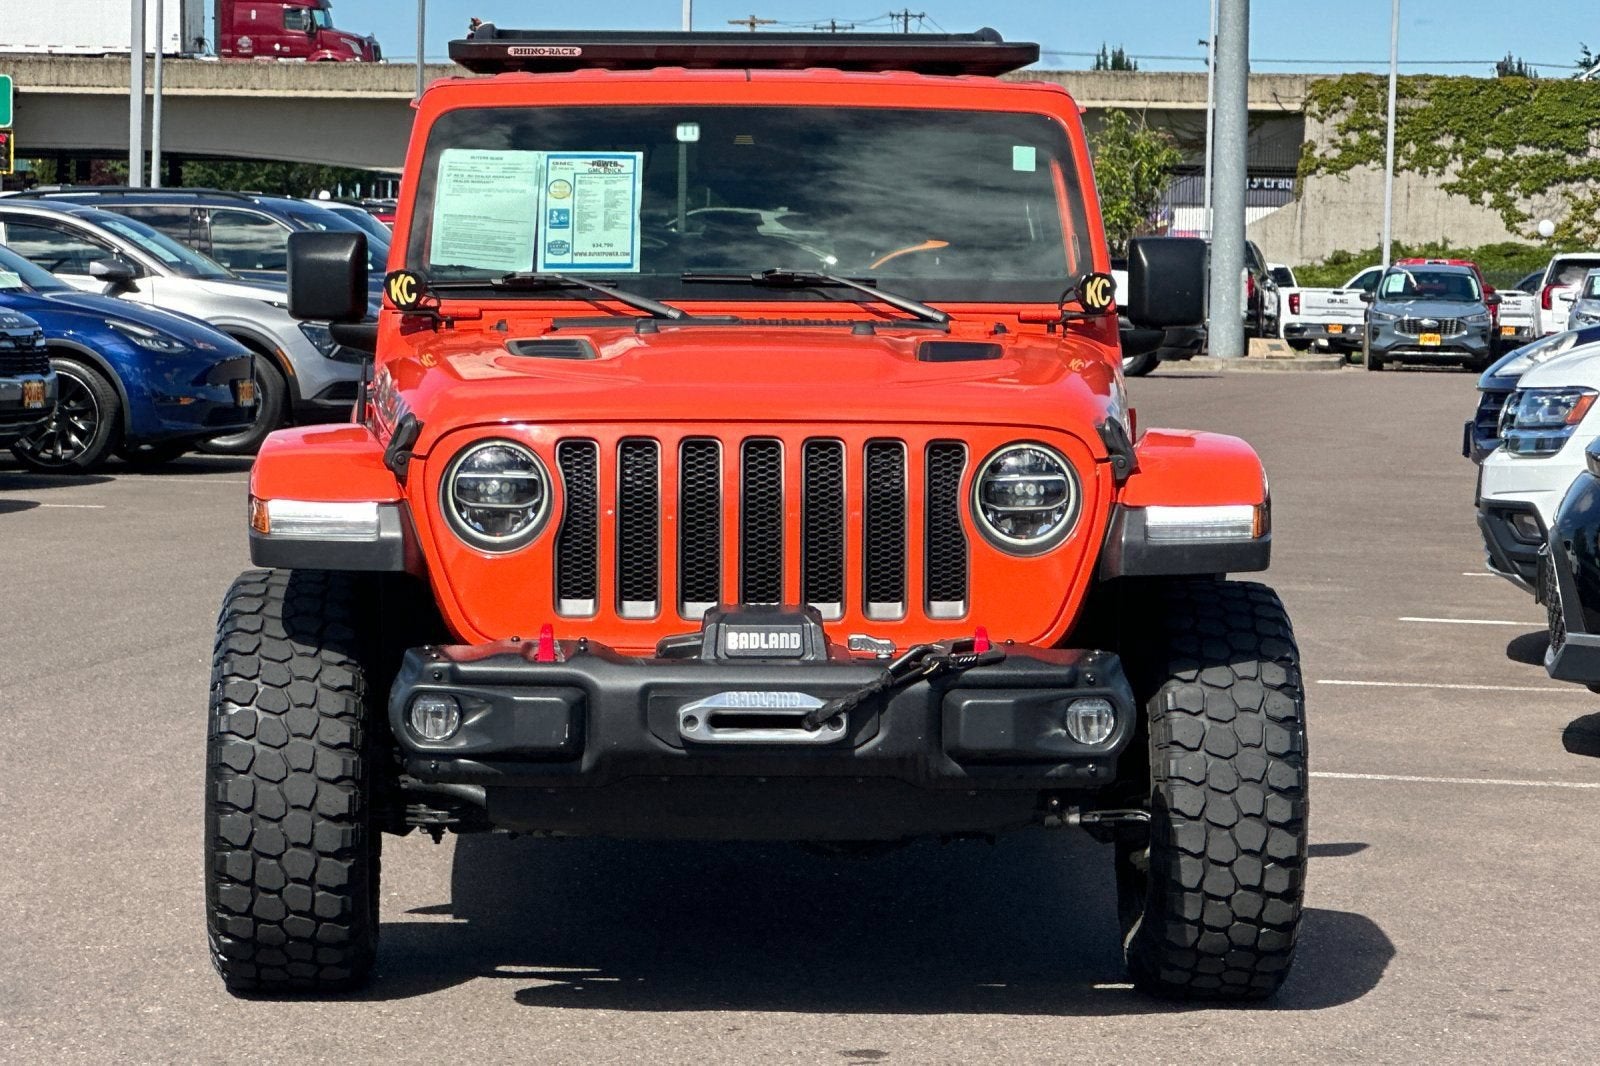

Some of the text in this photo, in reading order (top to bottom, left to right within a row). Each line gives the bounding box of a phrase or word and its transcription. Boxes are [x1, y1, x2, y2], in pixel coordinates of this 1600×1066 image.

[513, 47, 576, 55] RHINO-RACK
[390, 273, 417, 305] KC
[1086, 276, 1111, 308] KC
[727, 631, 801, 650] BADLAND
[725, 692, 801, 708] BADLAND
